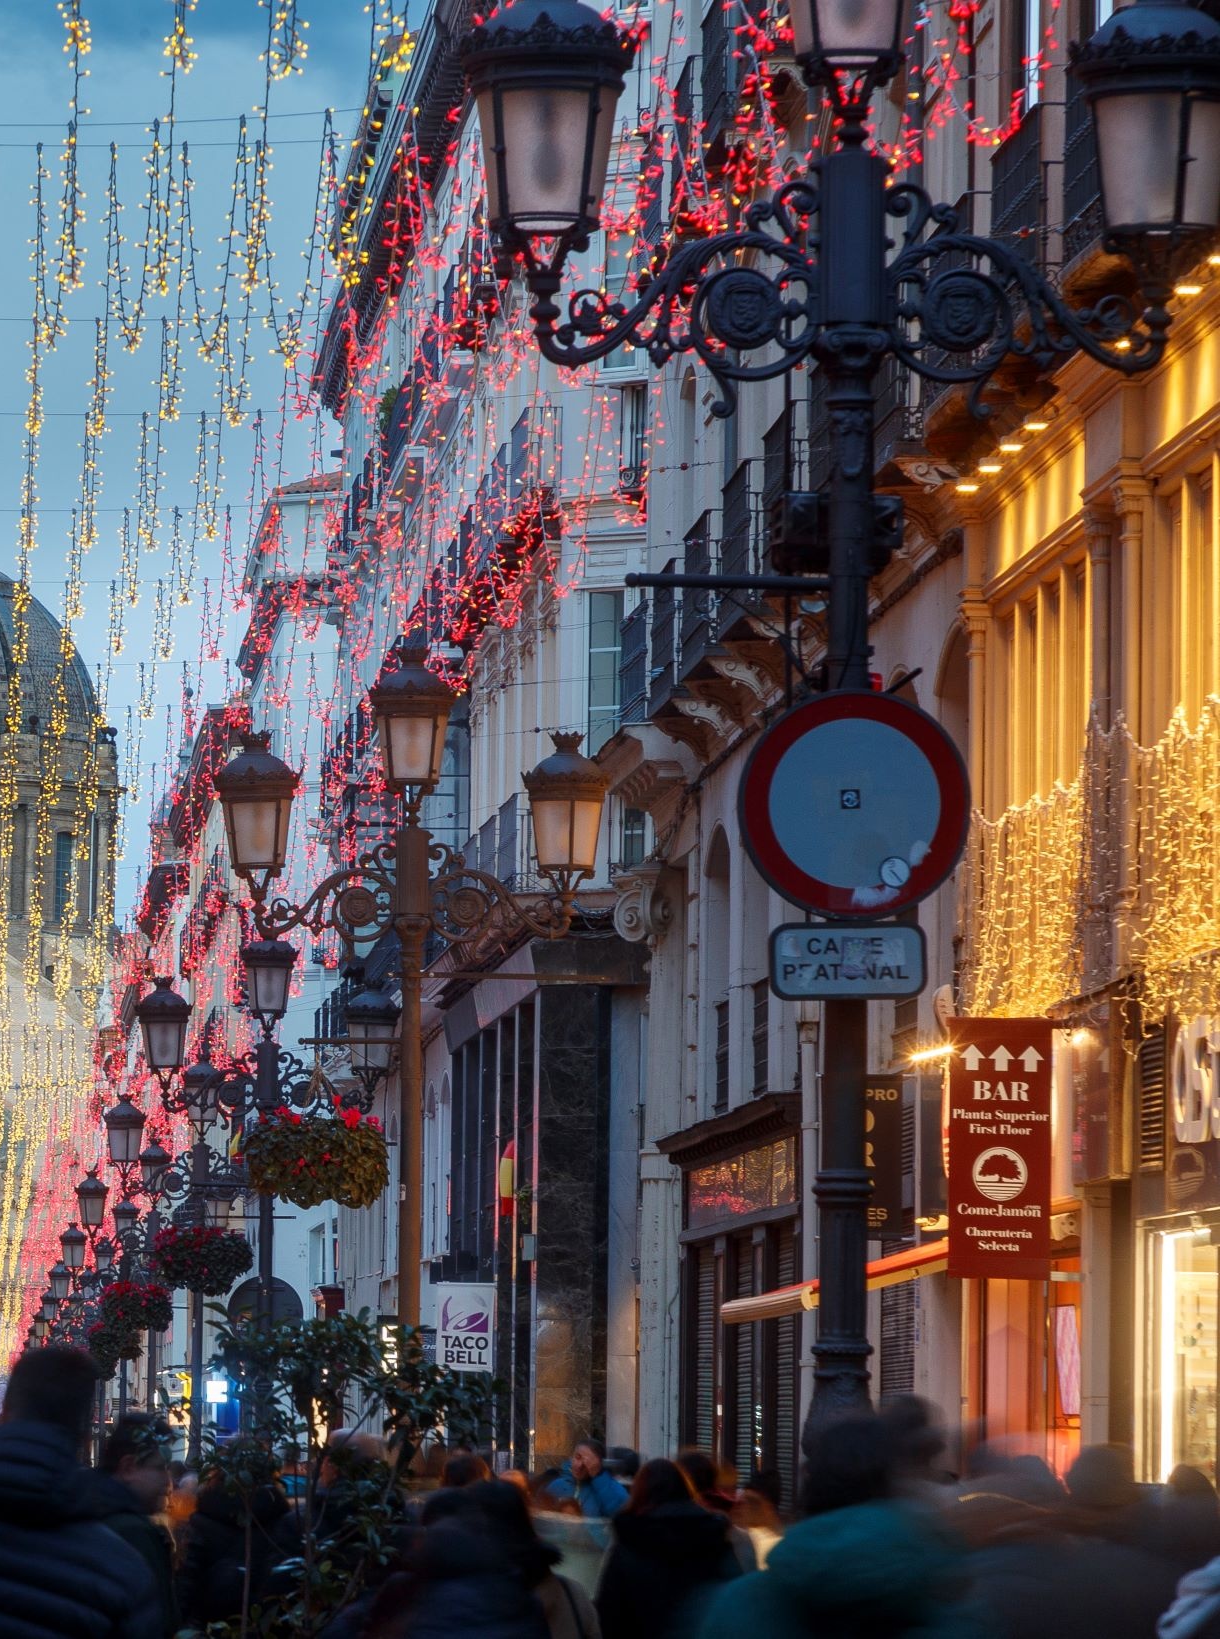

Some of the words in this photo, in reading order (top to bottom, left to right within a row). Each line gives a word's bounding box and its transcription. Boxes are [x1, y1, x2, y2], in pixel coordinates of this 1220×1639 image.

[807, 938, 884, 954] CAE
[972, 1080, 1030, 1101] BAR
[952, 1109, 992, 1120] Planta
[995, 1110, 1049, 1123] Superior
[969, 1123, 997, 1134] First
[1000, 1124, 1032, 1135] Floor
[965, 1226, 1033, 1239] Charcutería
[978, 1240, 1020, 1252] Selecta
[441, 1335, 489, 1350] TACO
[444, 1350, 488, 1365] BELL
